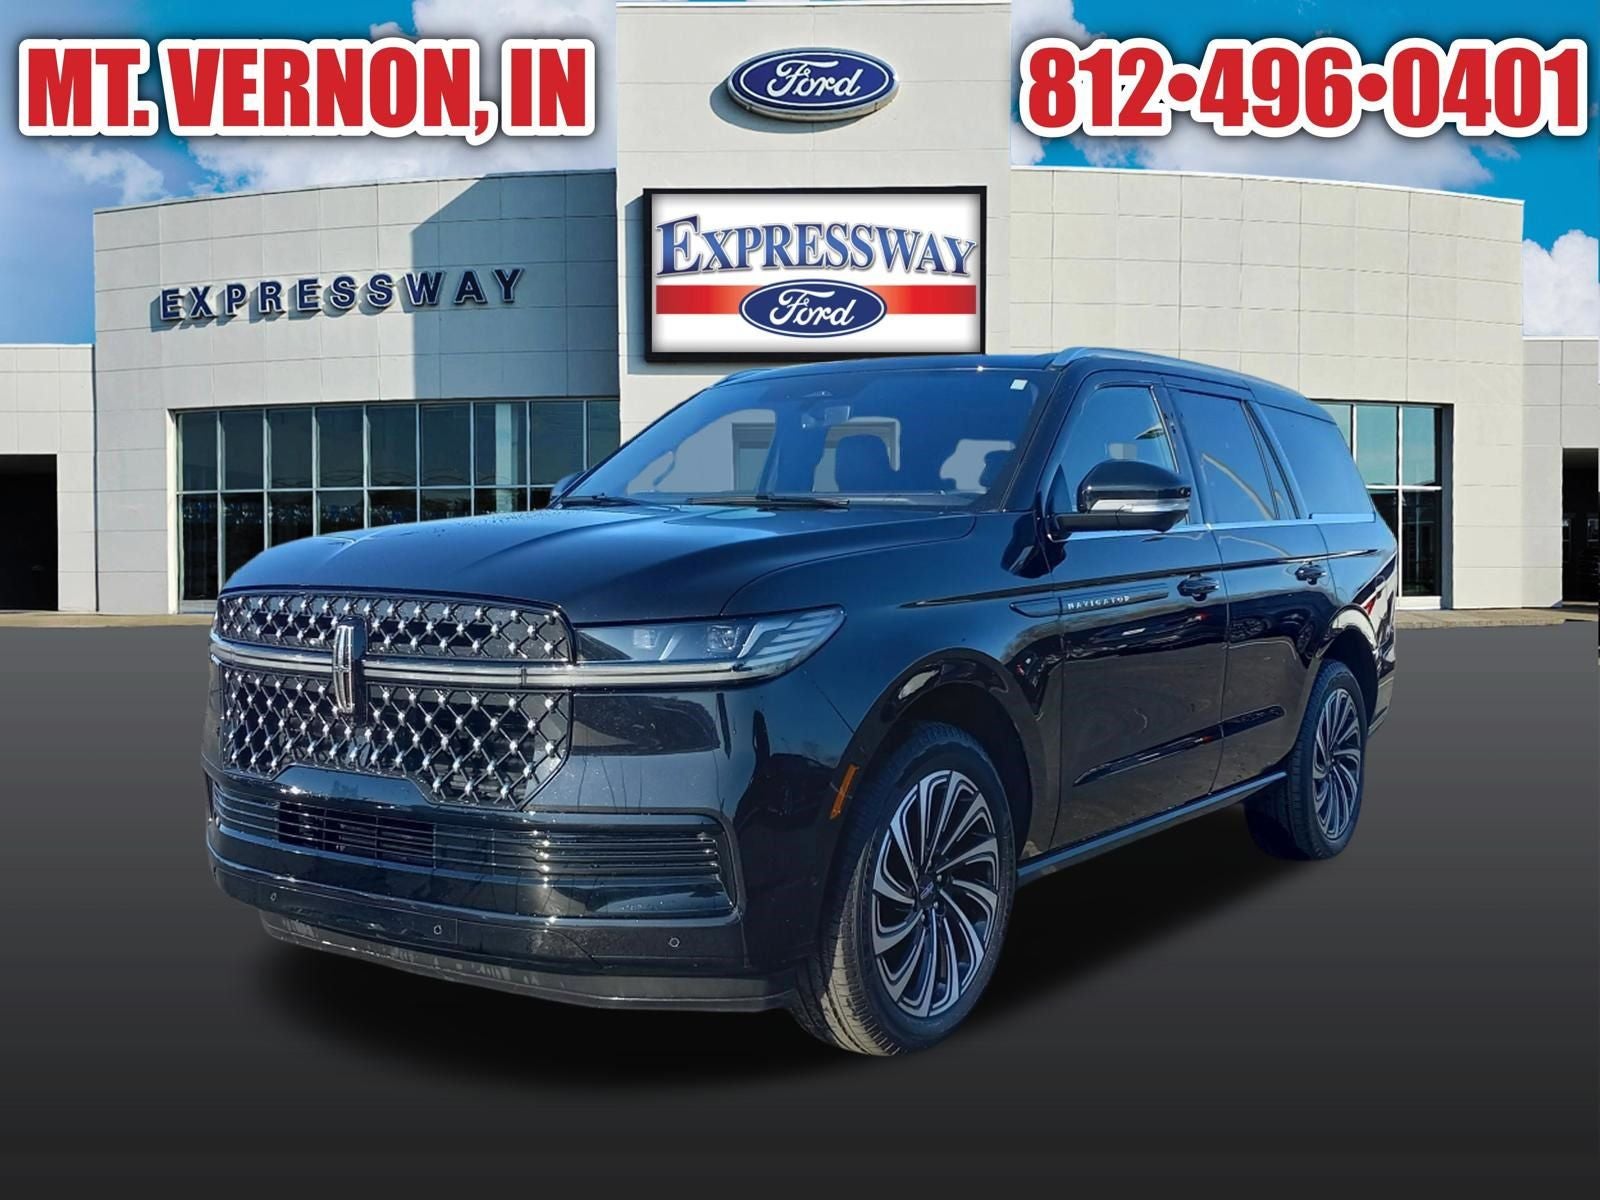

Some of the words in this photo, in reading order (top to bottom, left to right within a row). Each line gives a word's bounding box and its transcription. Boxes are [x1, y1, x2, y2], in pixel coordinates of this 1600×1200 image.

[766, 59, 864, 98] Ford
[160, 268, 524, 321] EXPRESSWAY
[769, 288, 857, 326] Ford
[1067, 595, 1131, 610] NAVIGATOR
